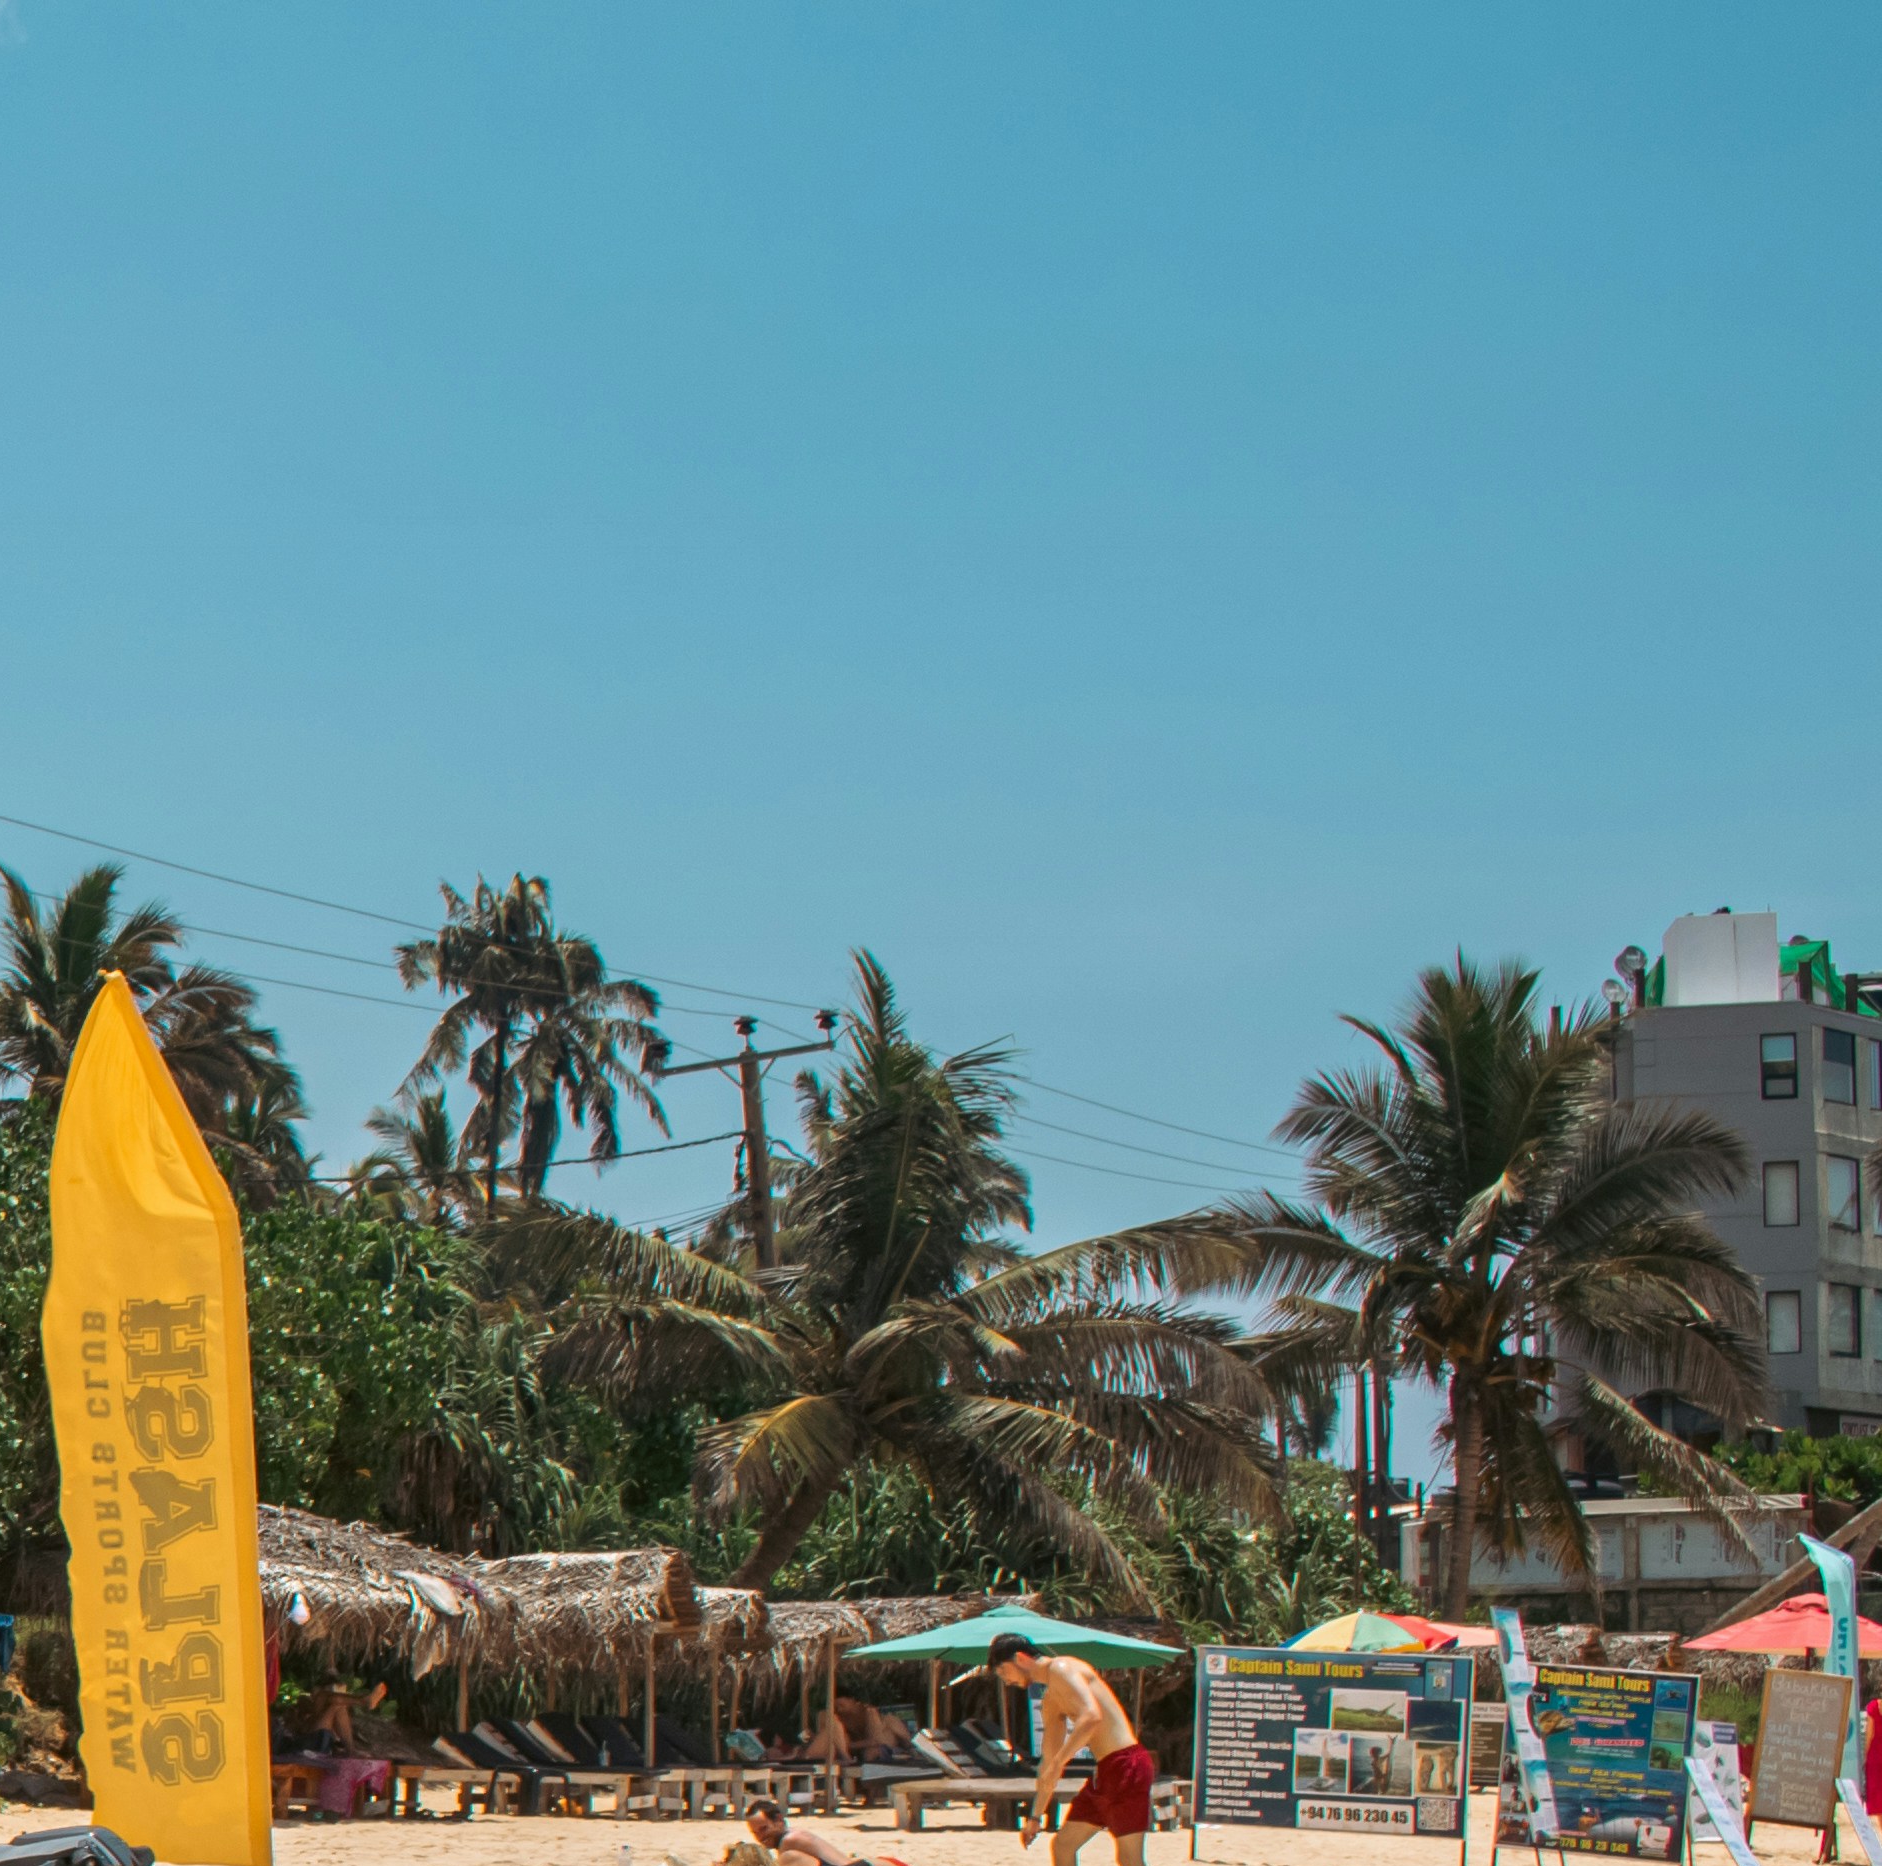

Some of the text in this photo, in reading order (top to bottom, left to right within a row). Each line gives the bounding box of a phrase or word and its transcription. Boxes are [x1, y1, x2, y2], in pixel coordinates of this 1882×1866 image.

[1228, 1657, 1283, 1675] Captain
[1285, 1660, 1321, 1676] Sami
[1324, 1661, 1364, 1678] Tours
[1539, 1668, 1651, 1692] Captain Sami Tours
[1300, 1806, 1408, 1824] +94 76 96 230 45
